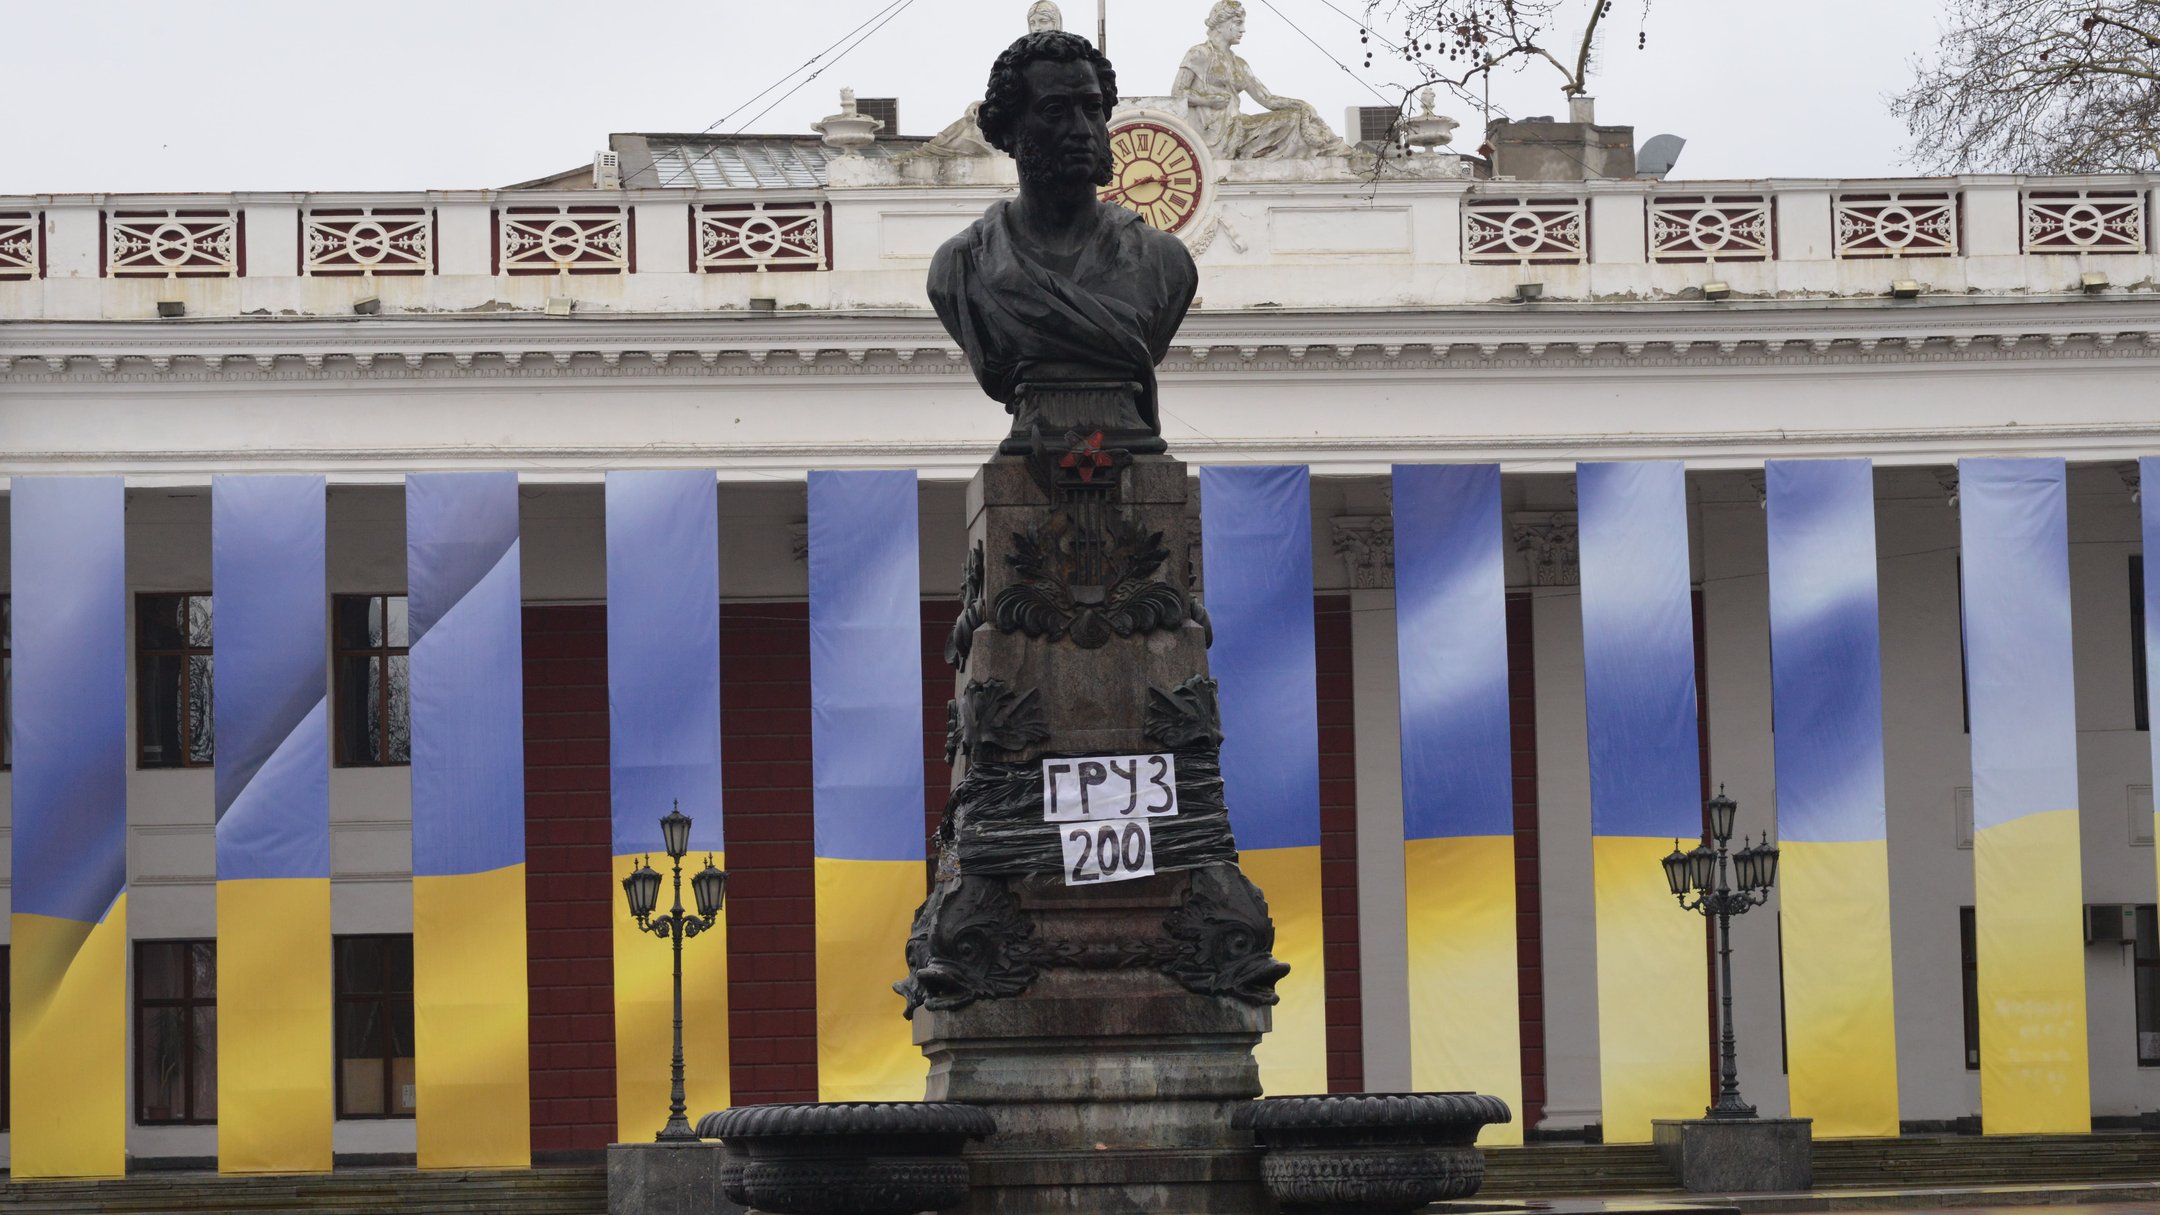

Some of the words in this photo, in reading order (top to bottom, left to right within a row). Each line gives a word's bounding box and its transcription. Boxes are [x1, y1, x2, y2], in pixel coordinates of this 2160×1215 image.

[1115, 139, 1131, 157] XI
[1048, 755, 1173, 815] ГРУЗ
[1069, 822, 1146, 881] 200
